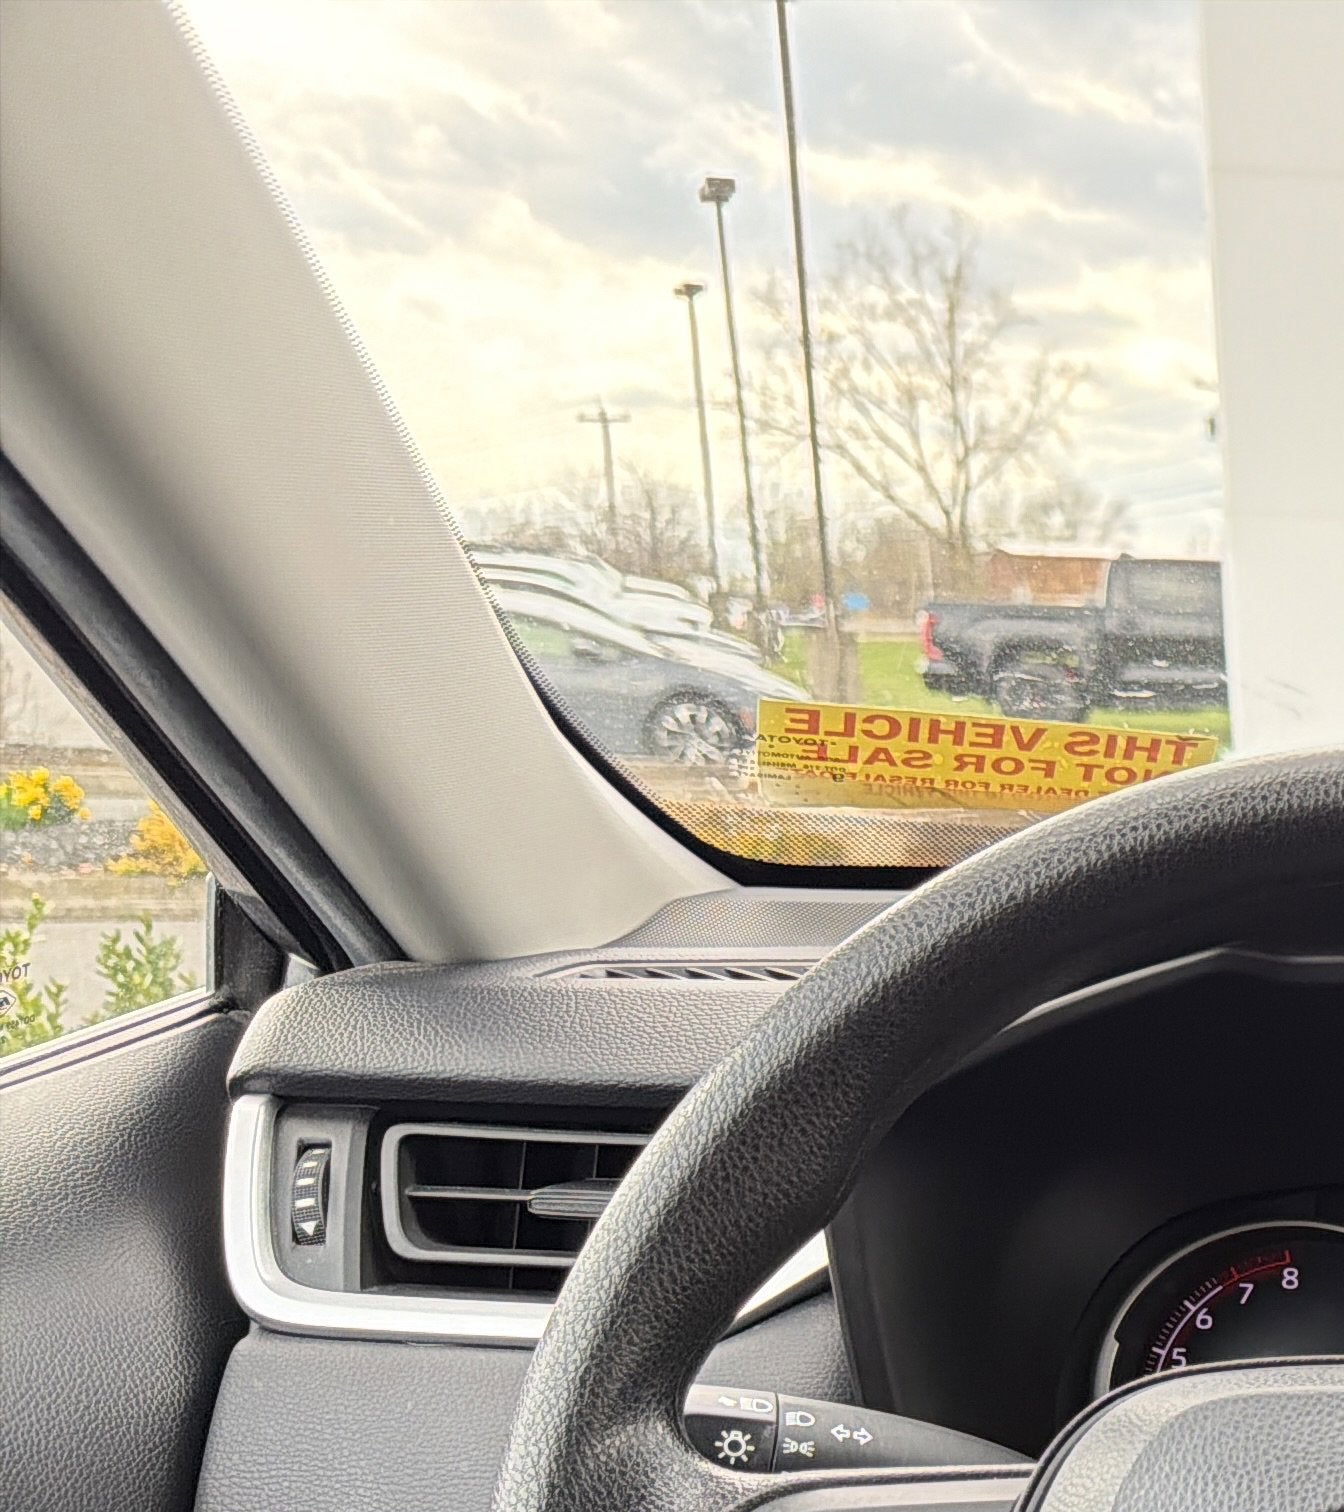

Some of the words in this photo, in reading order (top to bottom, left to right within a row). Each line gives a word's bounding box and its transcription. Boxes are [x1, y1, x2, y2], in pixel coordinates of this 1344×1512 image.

[1281, 1268, 1299, 1291] 8
[1238, 1283, 1255, 1305] 7
[1195, 1308, 1213, 1330] 6
[1171, 1347, 1187, 1368] 5
